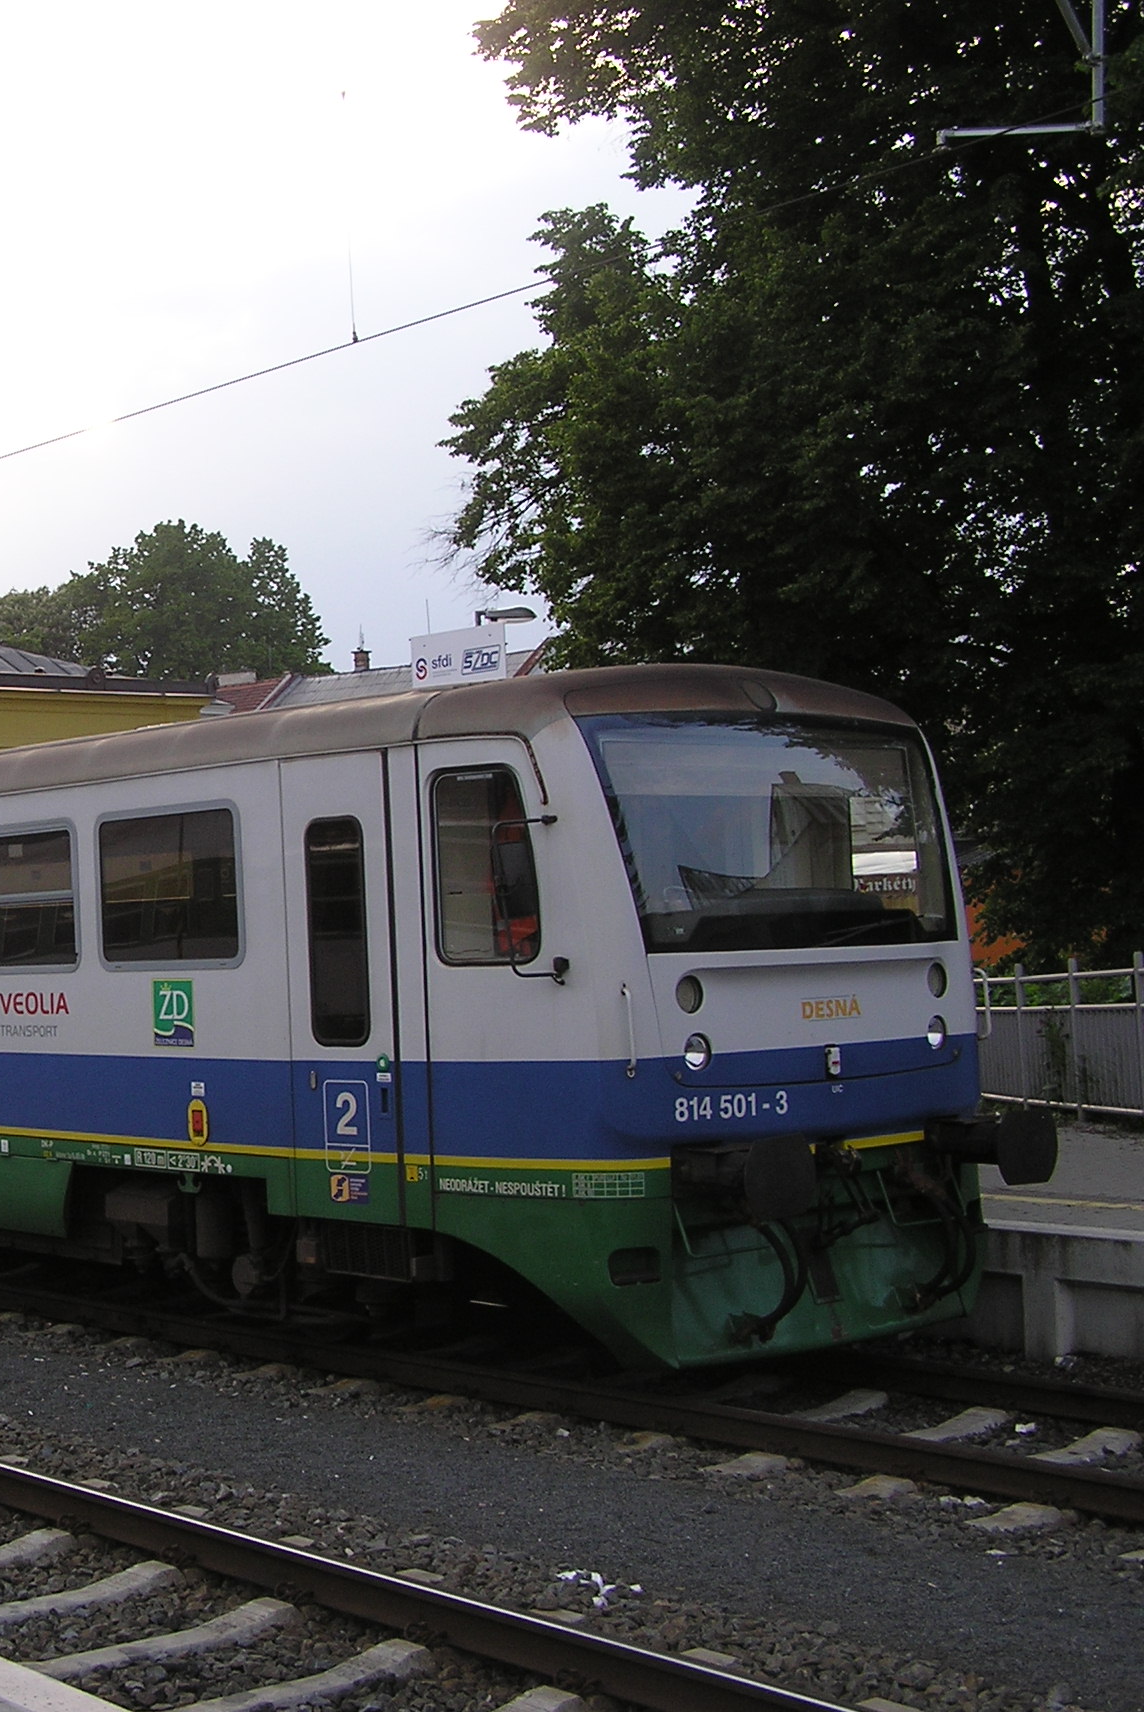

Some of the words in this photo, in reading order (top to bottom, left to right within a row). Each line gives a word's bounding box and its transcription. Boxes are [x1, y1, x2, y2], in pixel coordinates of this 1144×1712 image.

[431, 654, 452, 669] sfdi
[0, 992, 70, 1015] VEOLIA
[801, 994, 862, 1019] DESNÁ
[0, 1024, 58, 1038] TRANSPORT
[336, 1092, 358, 1135] 2
[675, 1096, 713, 1122] 814
[143, 1151, 156, 1165] 120
[439, 1177, 490, 1193] NEODRÁŽET
